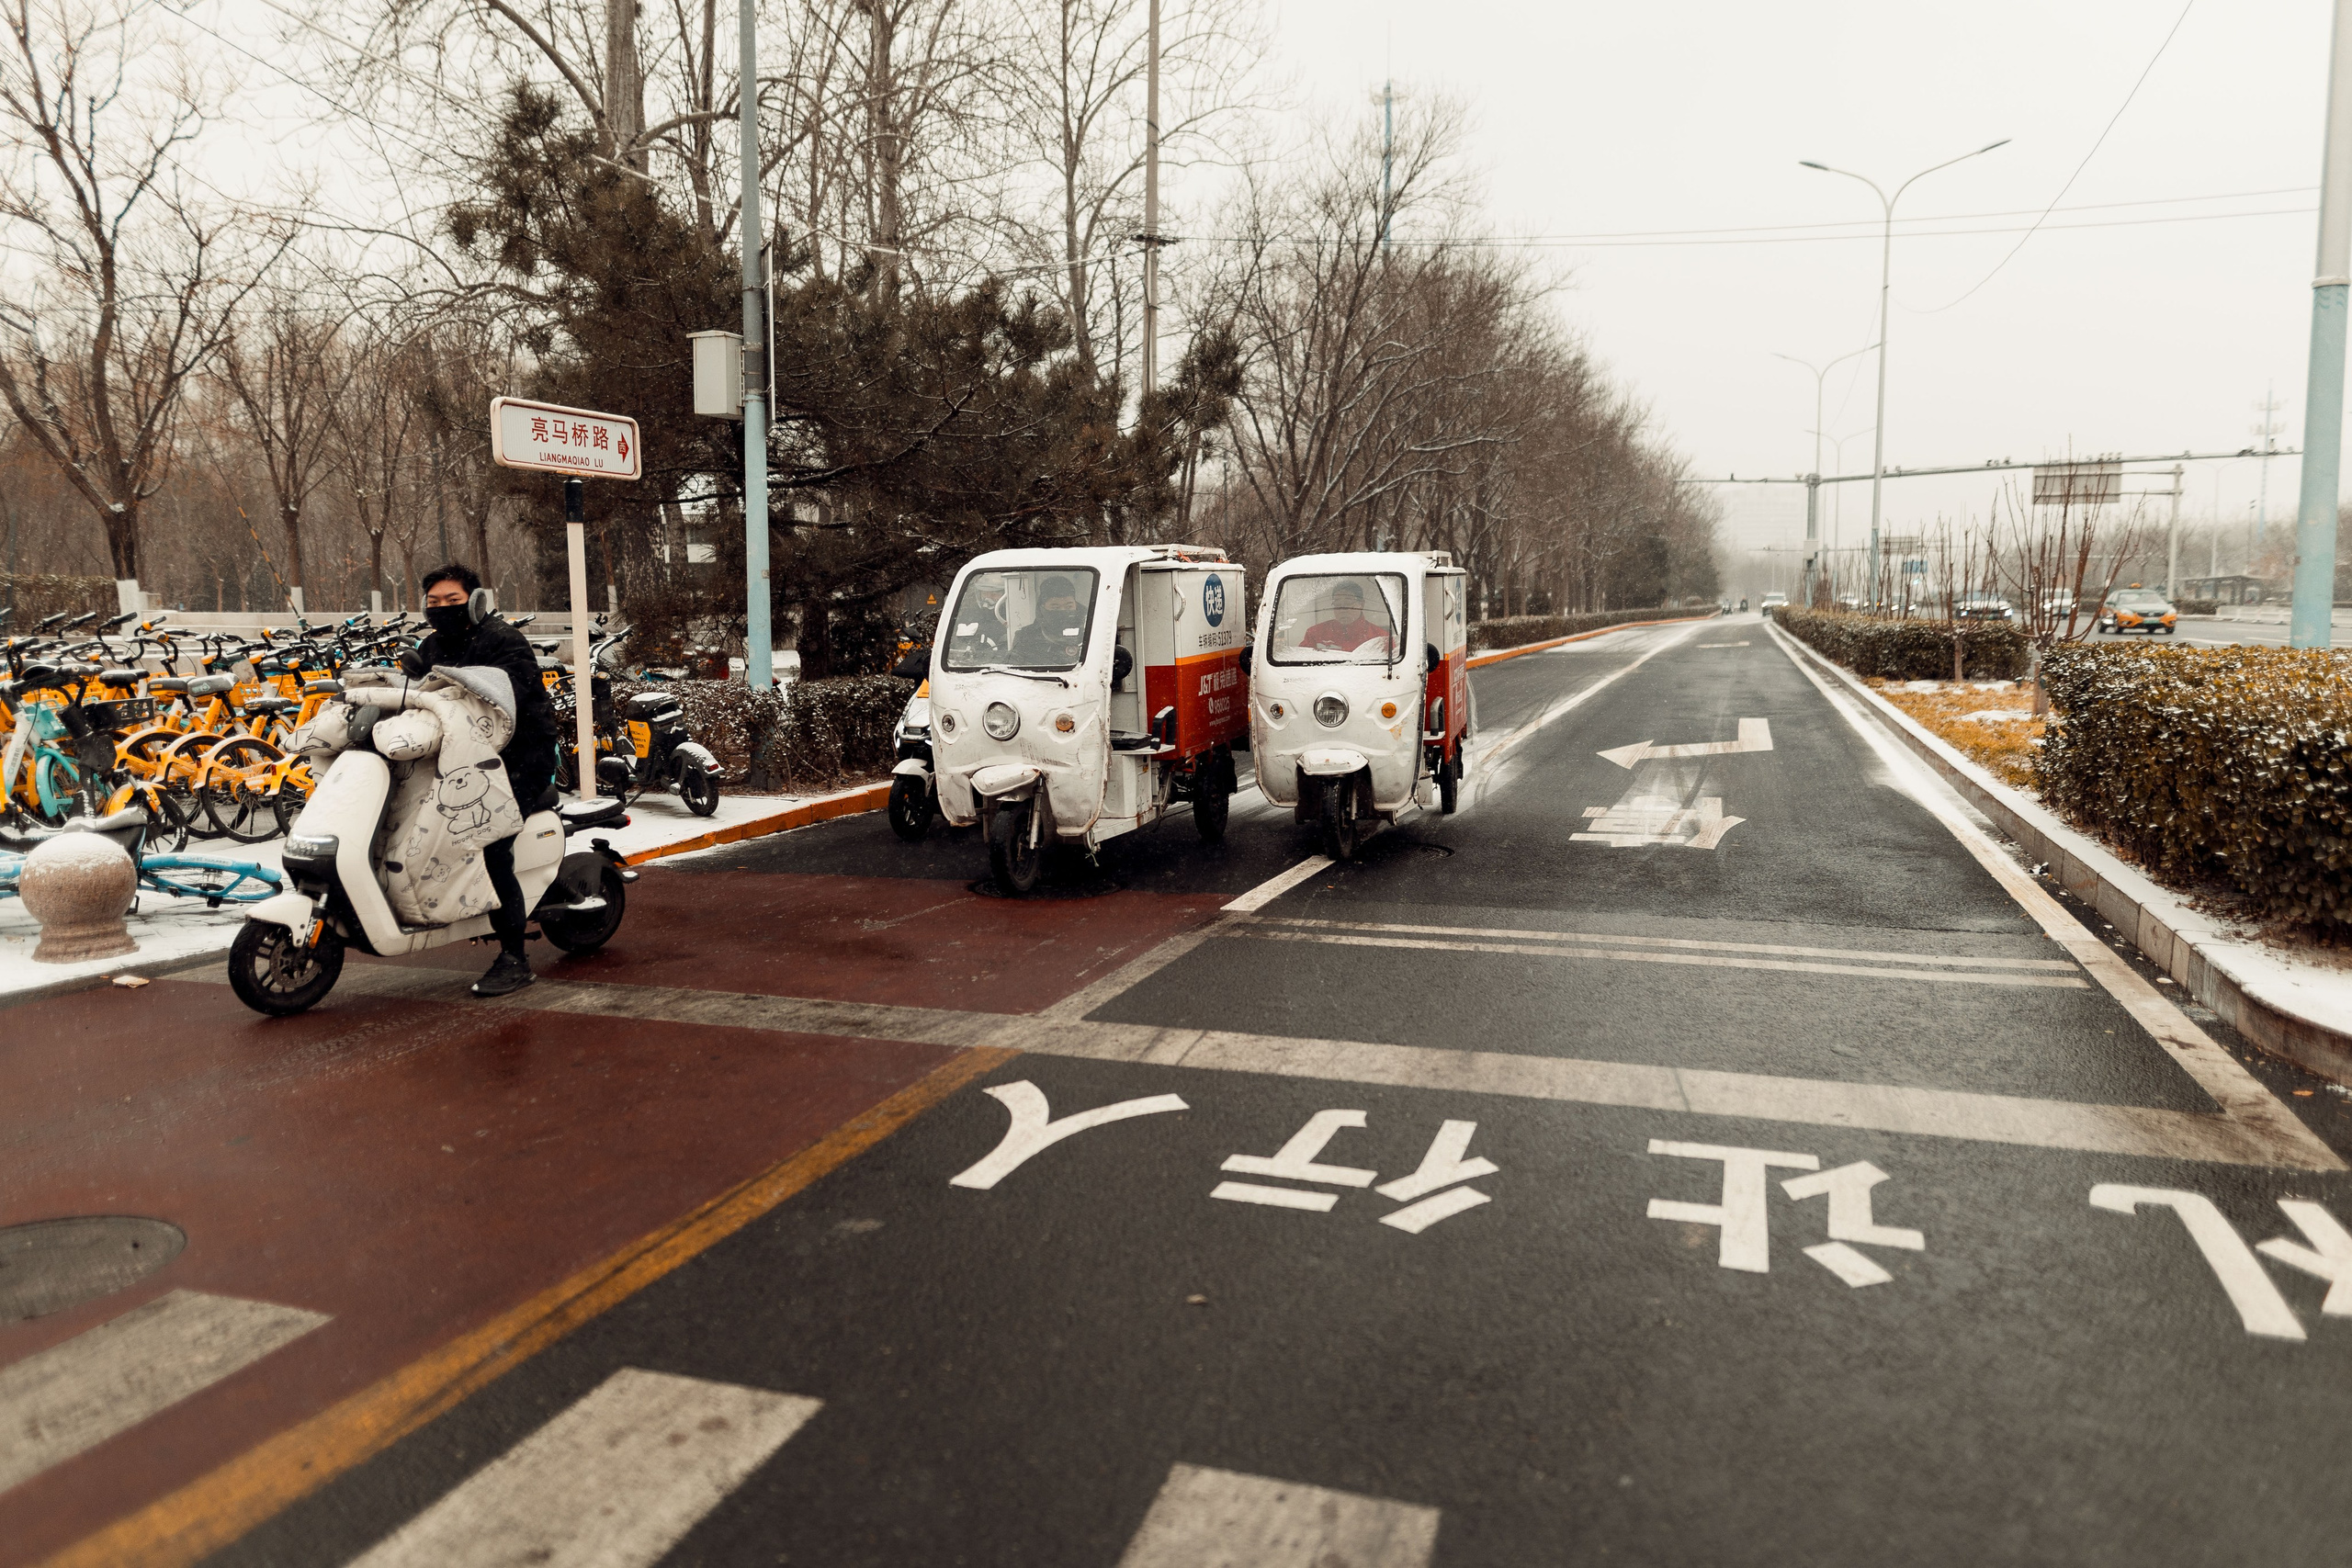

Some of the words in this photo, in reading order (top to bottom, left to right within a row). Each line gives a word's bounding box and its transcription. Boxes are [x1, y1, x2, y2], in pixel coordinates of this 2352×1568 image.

[531, 416, 609, 451] 亮马桥路
[539, 452, 590, 466] LIANGMAQIAO
[594, 458, 604, 468] LU
[1205, 584, 1223, 616] 快递
